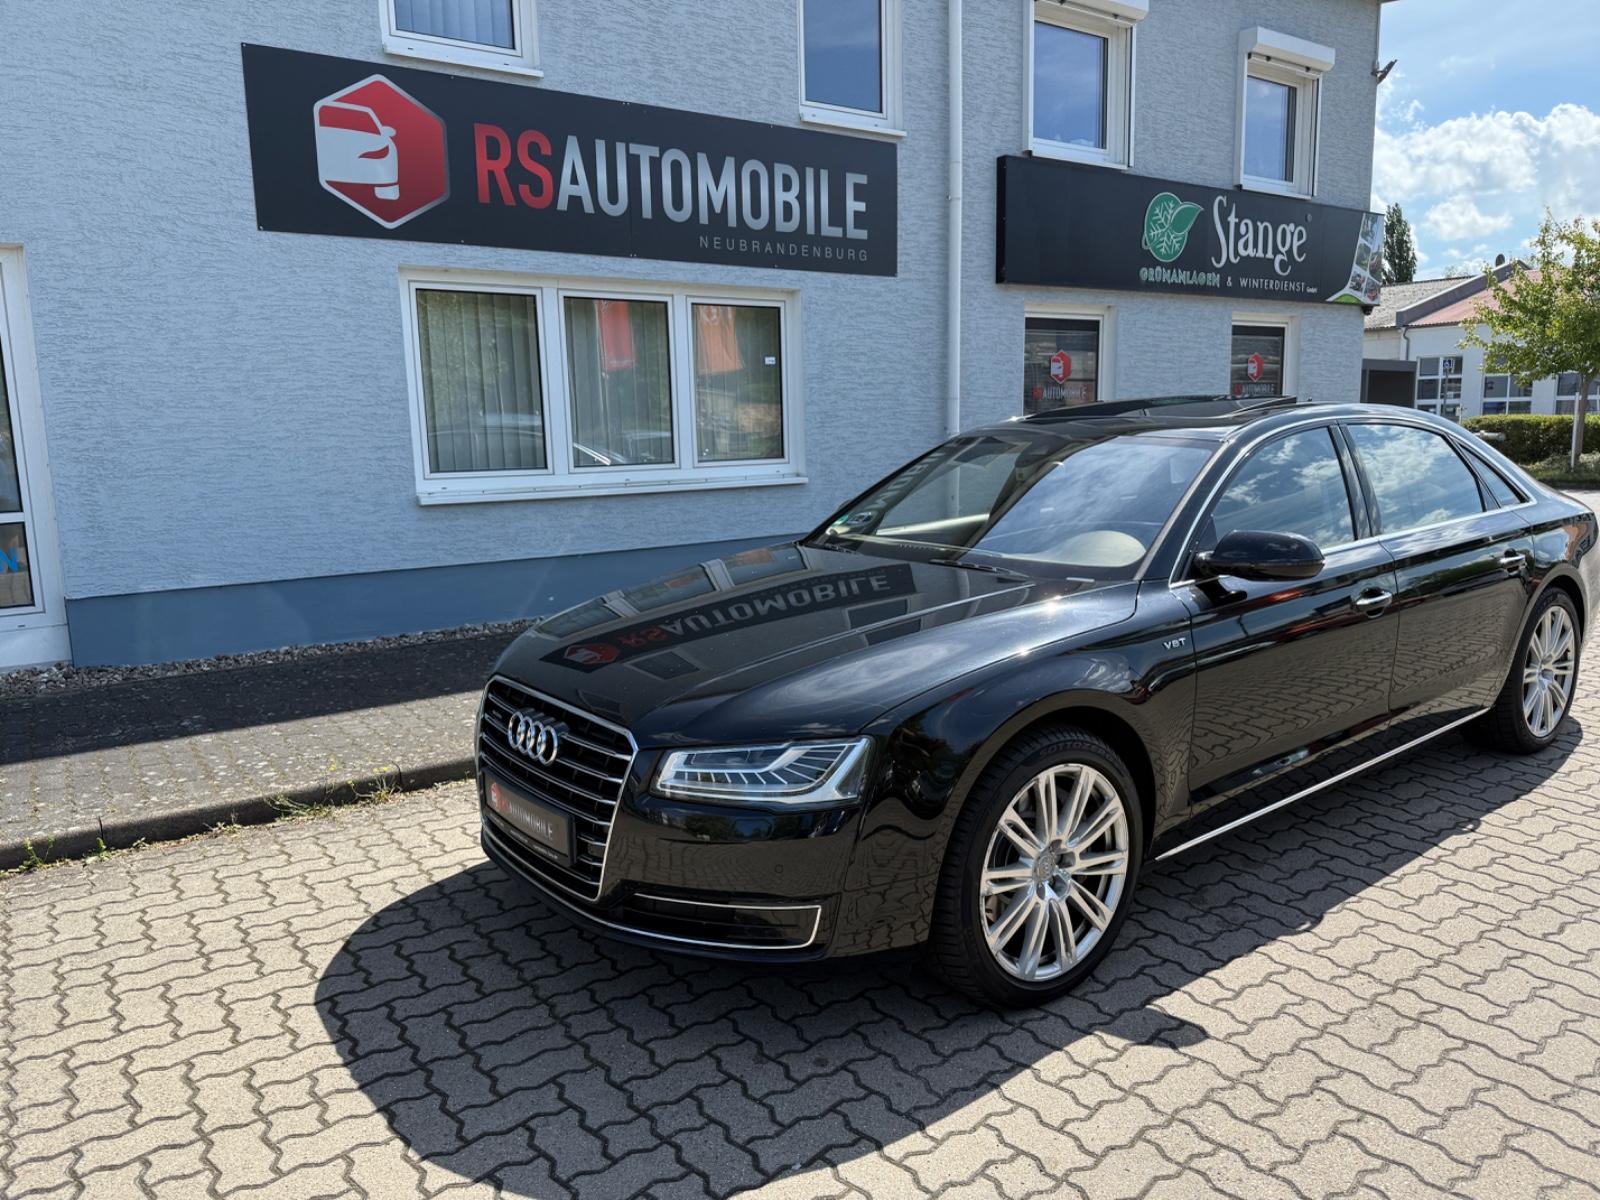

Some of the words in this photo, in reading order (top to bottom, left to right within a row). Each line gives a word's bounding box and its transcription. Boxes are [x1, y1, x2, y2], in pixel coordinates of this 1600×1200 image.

[699, 235, 868, 261] NEUBRANDENBURG
[1211, 195, 1307, 276] Stange
[1139, 266, 1220, 288] GRÜNANLAGEN
[1226, 276, 1233, 287] &
[1239, 277, 1305, 293] WINTERDIENST
